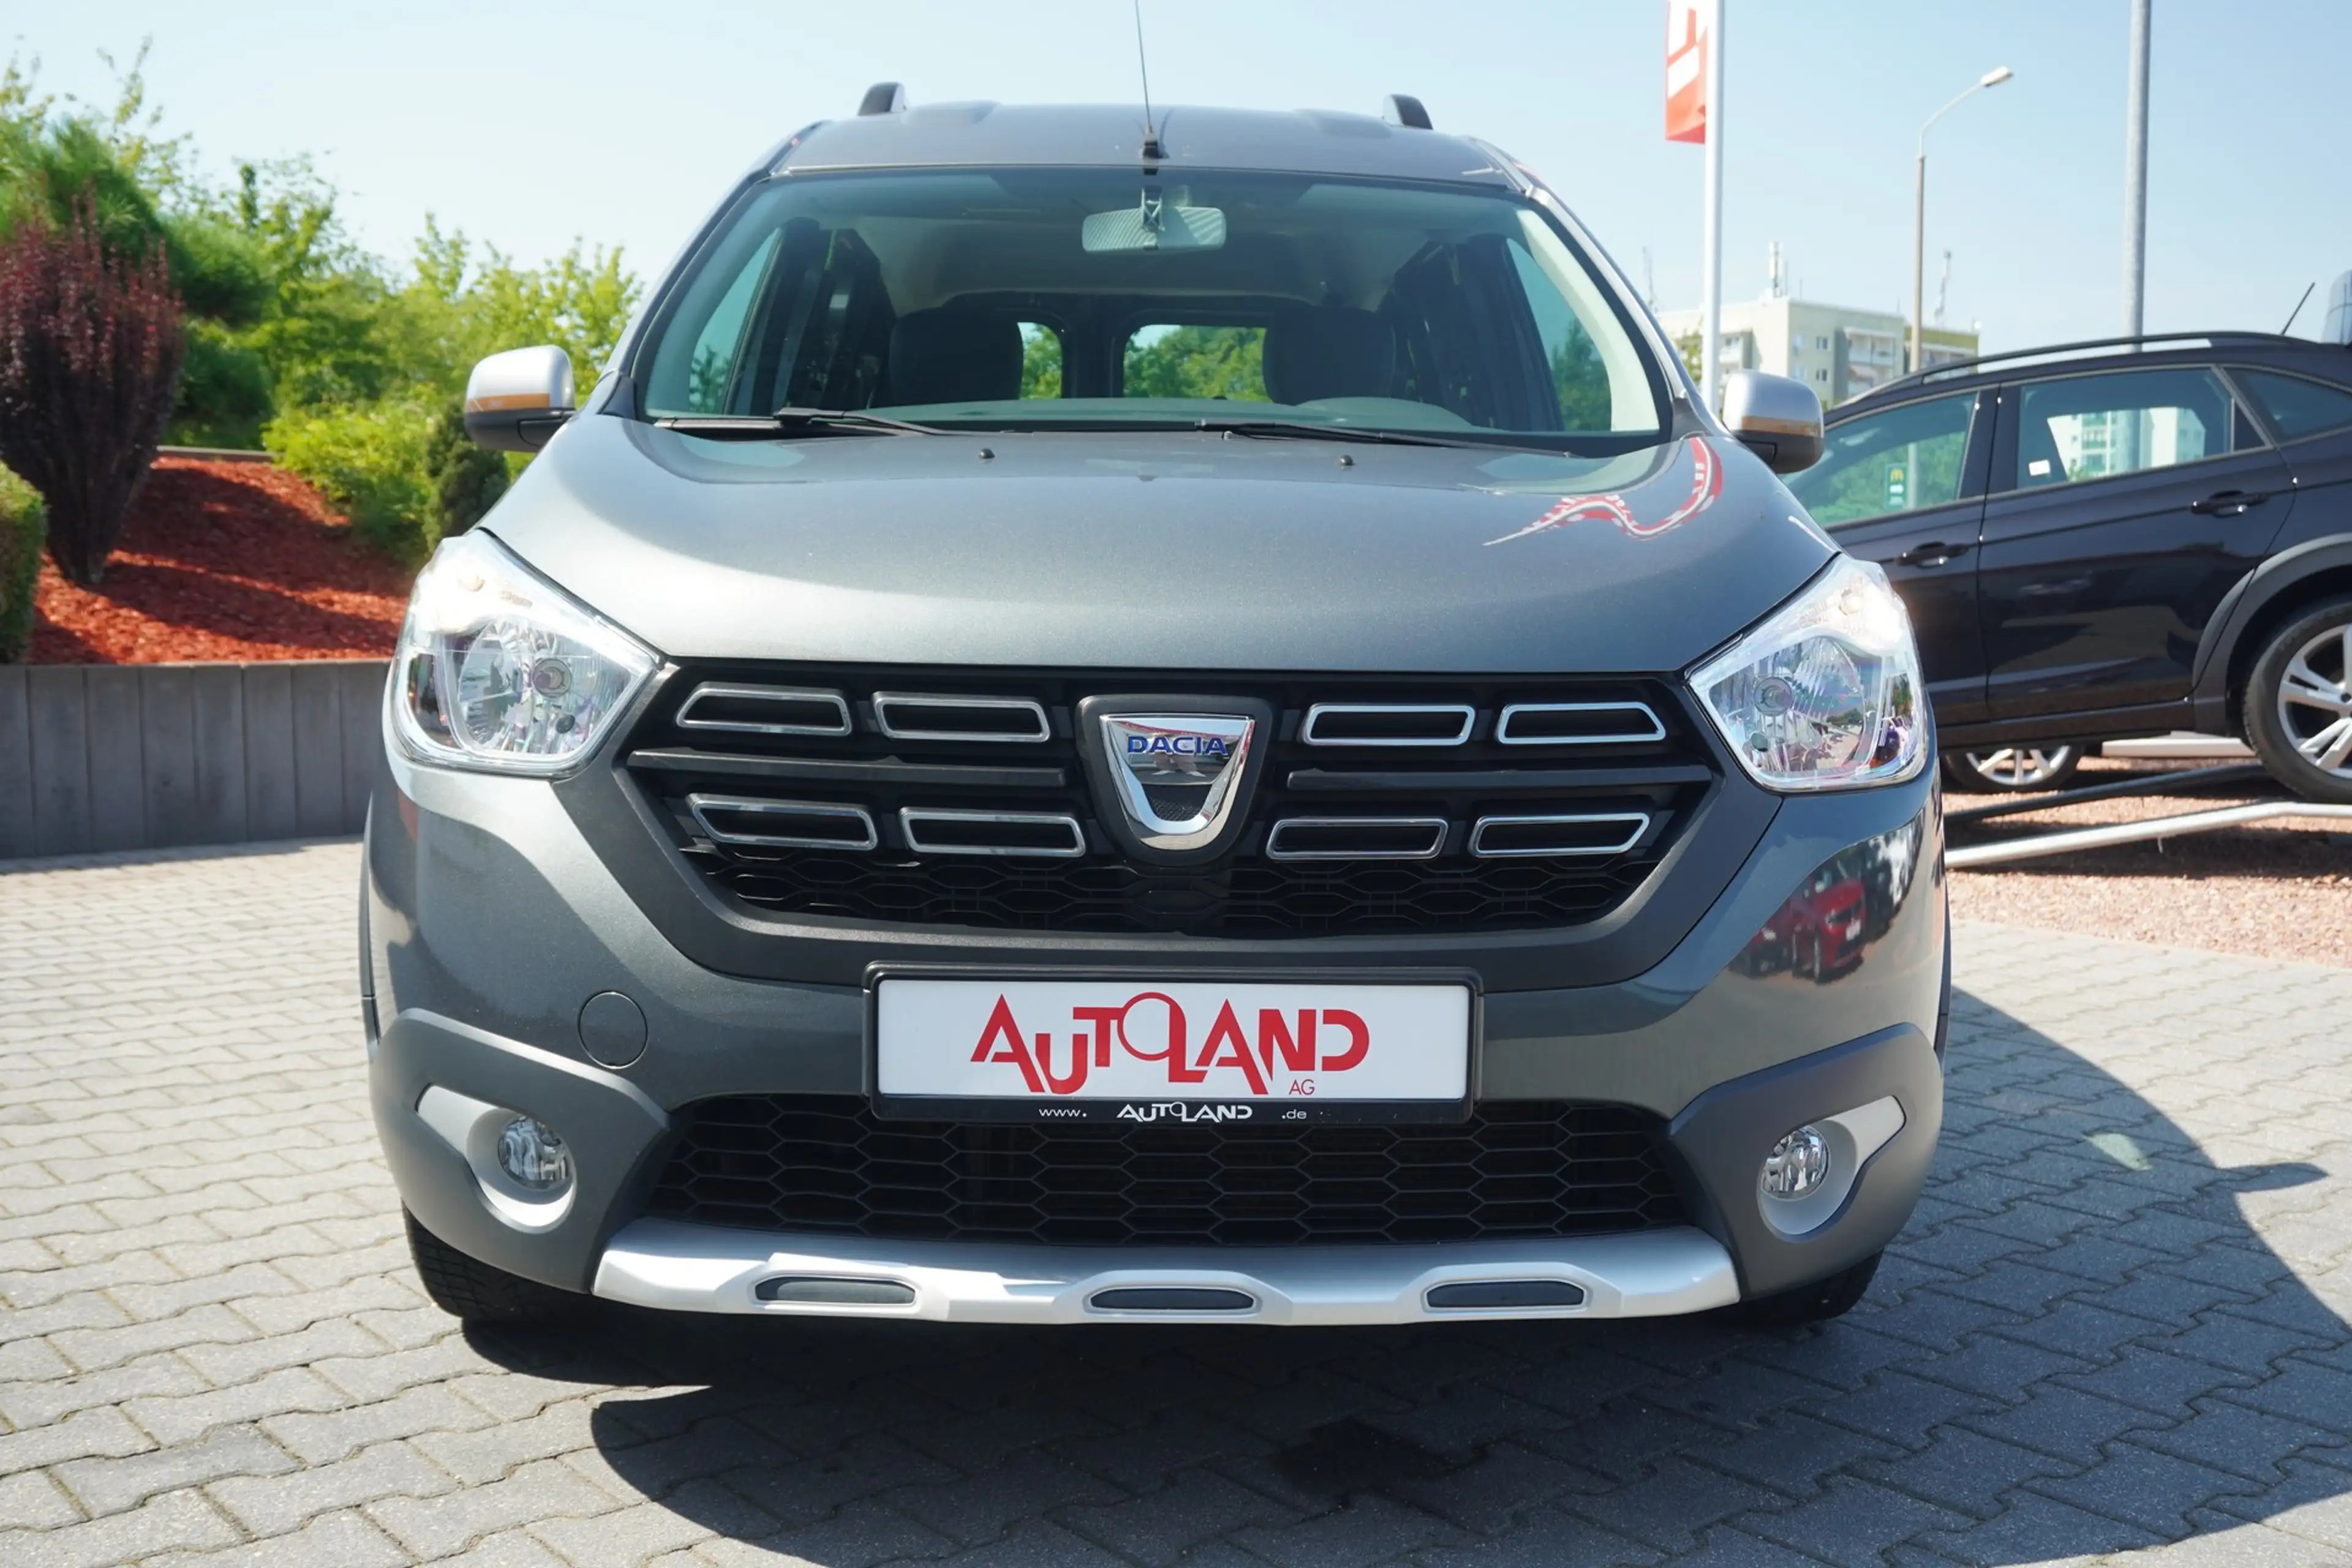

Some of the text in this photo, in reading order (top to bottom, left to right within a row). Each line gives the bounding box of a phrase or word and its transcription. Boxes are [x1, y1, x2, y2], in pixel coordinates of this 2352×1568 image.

[1127, 736, 1228, 755] DACIA
[970, 991, 1371, 1096] AUTOLAND
[1289, 1079, 1316, 1095] AG
[1038, 1101, 1307, 1123] www. AUTOLAND .de
